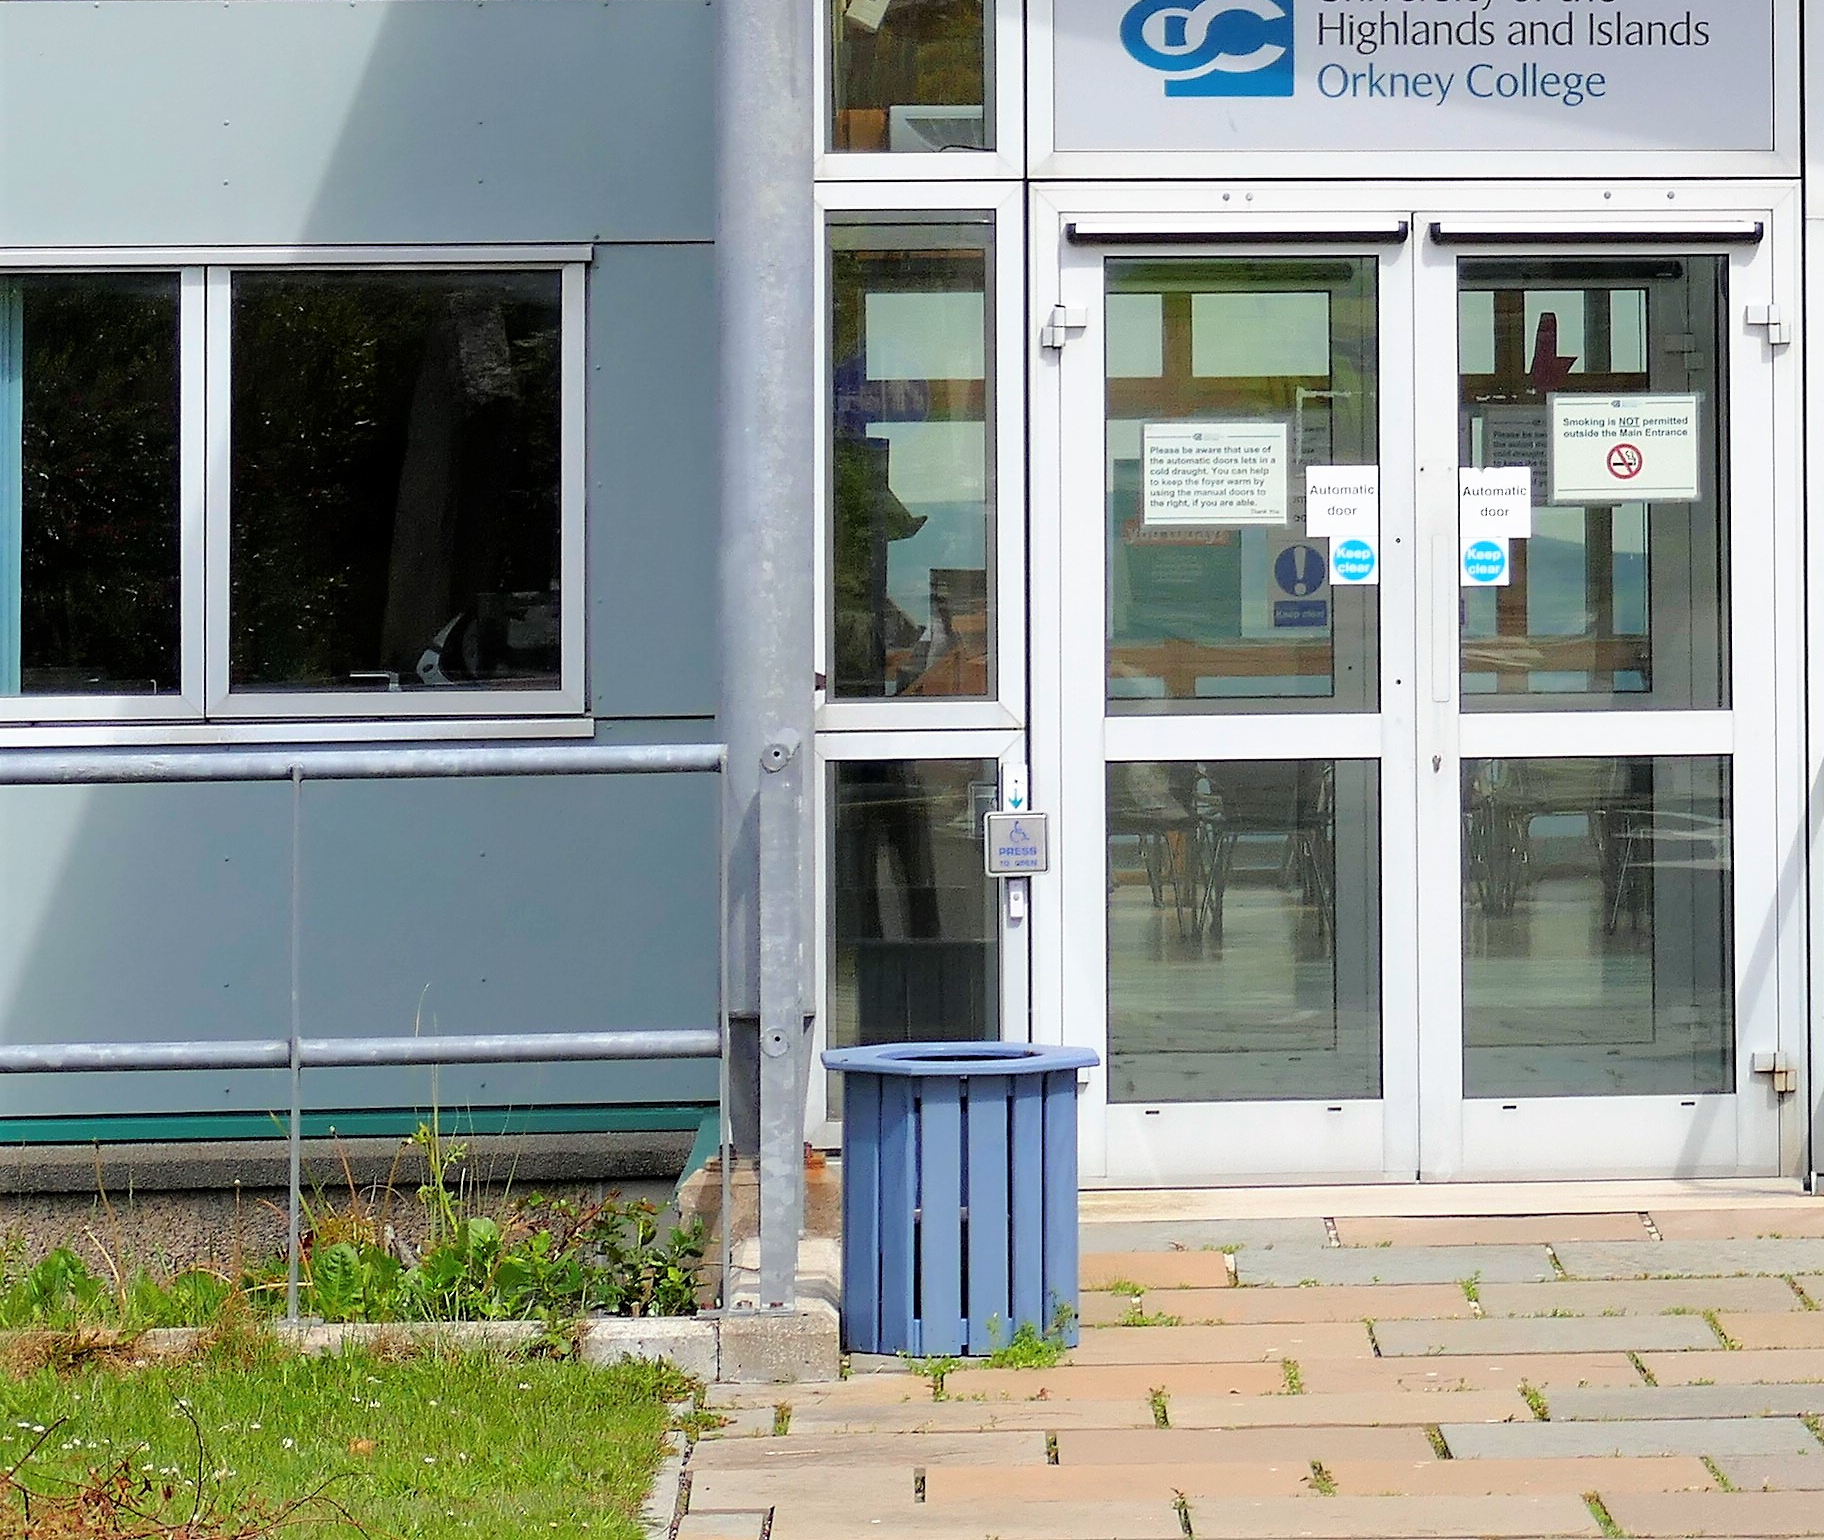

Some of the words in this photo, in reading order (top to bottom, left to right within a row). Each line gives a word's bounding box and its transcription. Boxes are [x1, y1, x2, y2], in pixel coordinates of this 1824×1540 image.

[1316, 11, 1496, 55] Highlands
[1506, 11, 1574, 47] and
[1588, 11, 1711, 48] Islands
[1316, 62, 1455, 106] Orkney
[1465, 62, 1606, 107] College
[1563, 417, 1605, 428] Smoking
[1607, 417, 1616, 426] is
[1619, 417, 1640, 427] NOT
[1642, 416, 1688, 427] permitted
[1563, 429, 1599, 438] outside
[1602, 429, 1617, 437] the
[1619, 429, 1643, 437] Main
[1645, 428, 1688, 437] Entrance
[1149, 446, 1180, 454] Please
[1182, 446, 1193, 454] be
[1224, 445, 1242, 454] that
[1262, 445, 1272, 453] of
[1149, 457, 1164, 465] the
[1166, 456, 1211, 465] automatic
[1212, 456, 1239, 465] doors
[1241, 456, 1257, 464] lets
[1259, 456, 1268, 464] in
[1149, 467, 1170, 476] cold
[1211, 467, 1230, 475] You
[1249, 466, 1270, 476] help
[1149, 478, 1159, 486] to
[1161, 478, 1183, 487] keep
[1185, 478, 1199, 486] the
[1201, 477, 1225, 487] foyer
[1227, 478, 1252, 486] warm
[1254, 477, 1264, 488] by
[1149, 488, 1175, 498] using
[1177, 488, 1191, 496] the
[1193, 488, 1227, 496] manual
[1228, 488, 1255, 496] doors
[1257, 488, 1266, 496] to
[1310, 484, 1375, 496] Automatic
[1463, 484, 1527, 497] Automatic
[1149, 499, 1164, 507] the
[1192, 499, 1198, 507] if
[1200, 500, 1218, 508] you
[1327, 505, 1358, 517] door
[1480, 506, 1510, 518] door
[1335, 547, 1372, 561] Keep
[1467, 548, 1502, 563] Keep
[1337, 561, 1371, 574] clear
[1467, 563, 1501, 575] clear
[998, 846, 1037, 856] PRESS
[1014, 859, 1037, 867] OPEN
